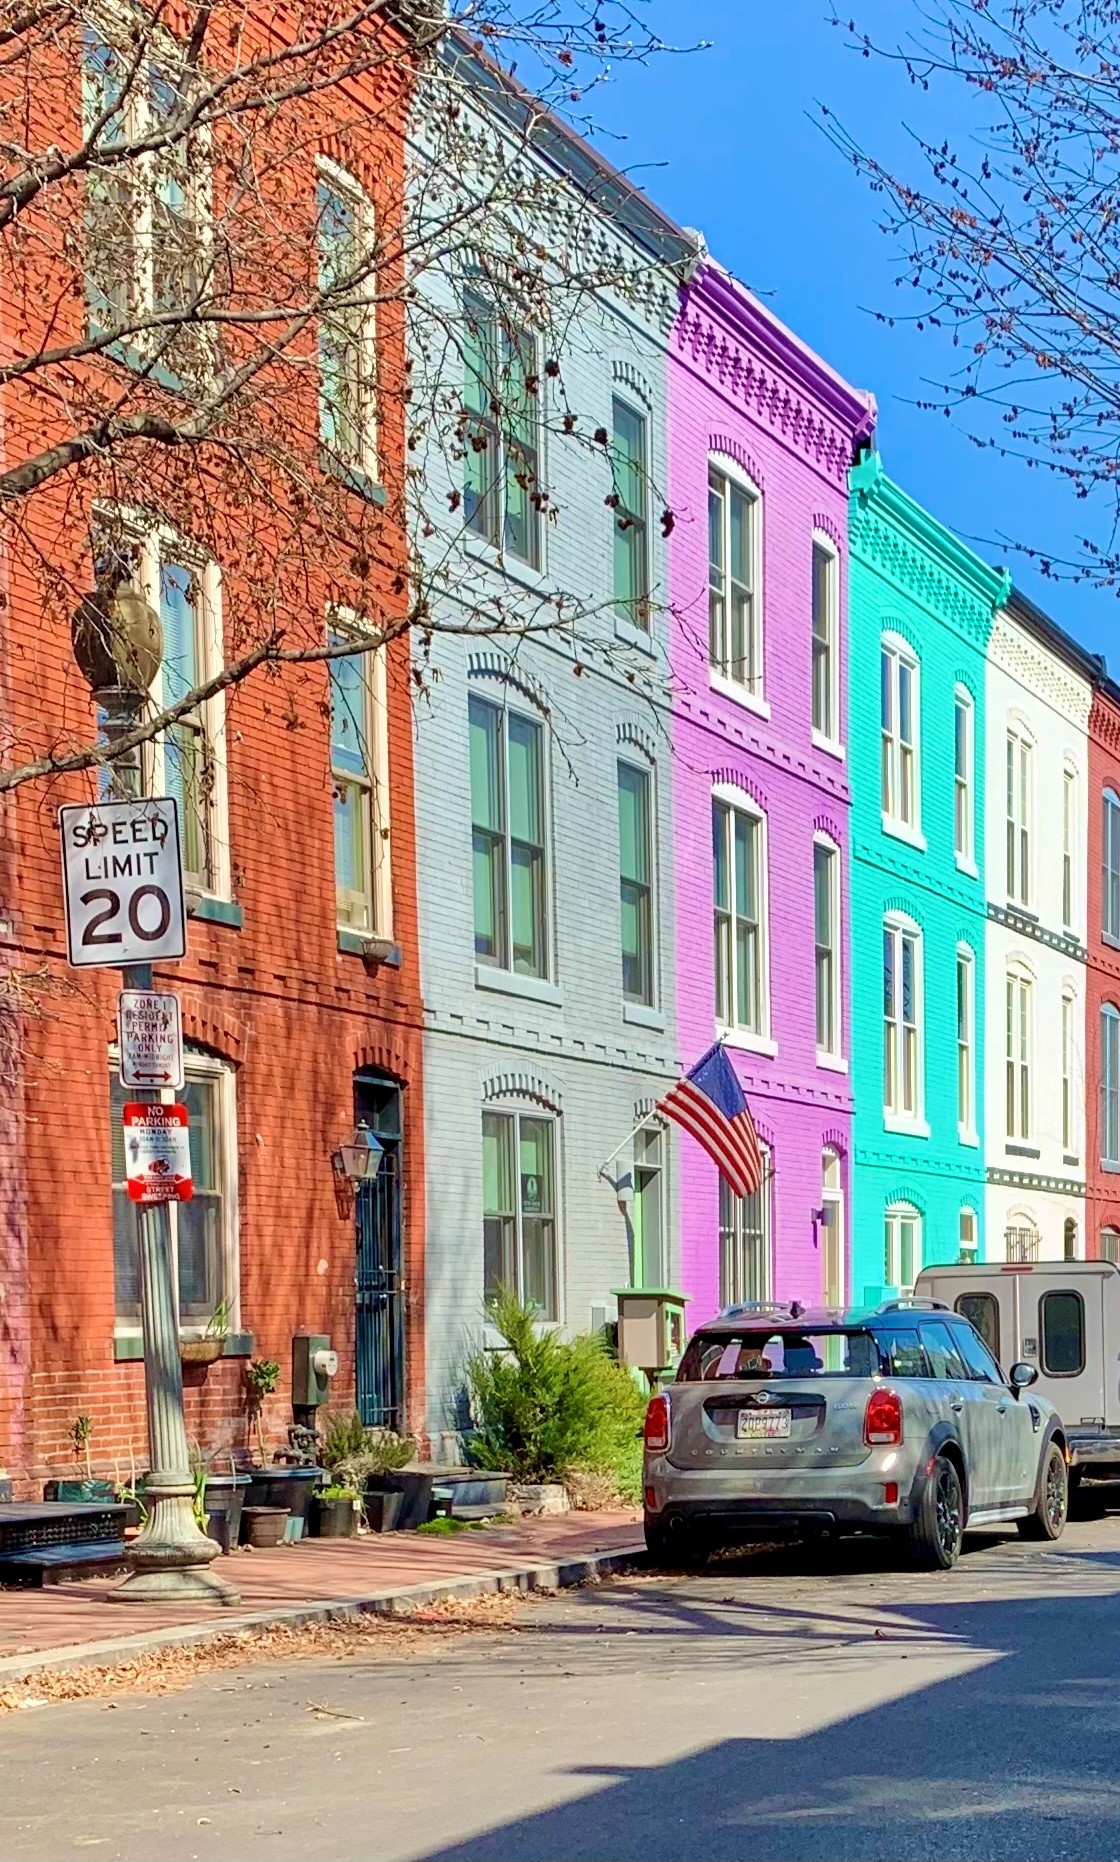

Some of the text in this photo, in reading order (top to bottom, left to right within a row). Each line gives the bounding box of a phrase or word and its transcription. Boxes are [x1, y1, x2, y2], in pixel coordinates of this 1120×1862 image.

[72, 818, 169, 848] SPEED
[85, 852, 159, 880] LIMIT
[79, 884, 171, 946] 20
[133, 999, 167, 1010] ZONE 1
[132, 1021, 168, 1032] PERMI
[127, 1032, 174, 1043] PARKING
[137, 1044, 162, 1053] ONLY
[147, 1106, 164, 1116] NO
[131, 1117, 181, 1127] PARKING
